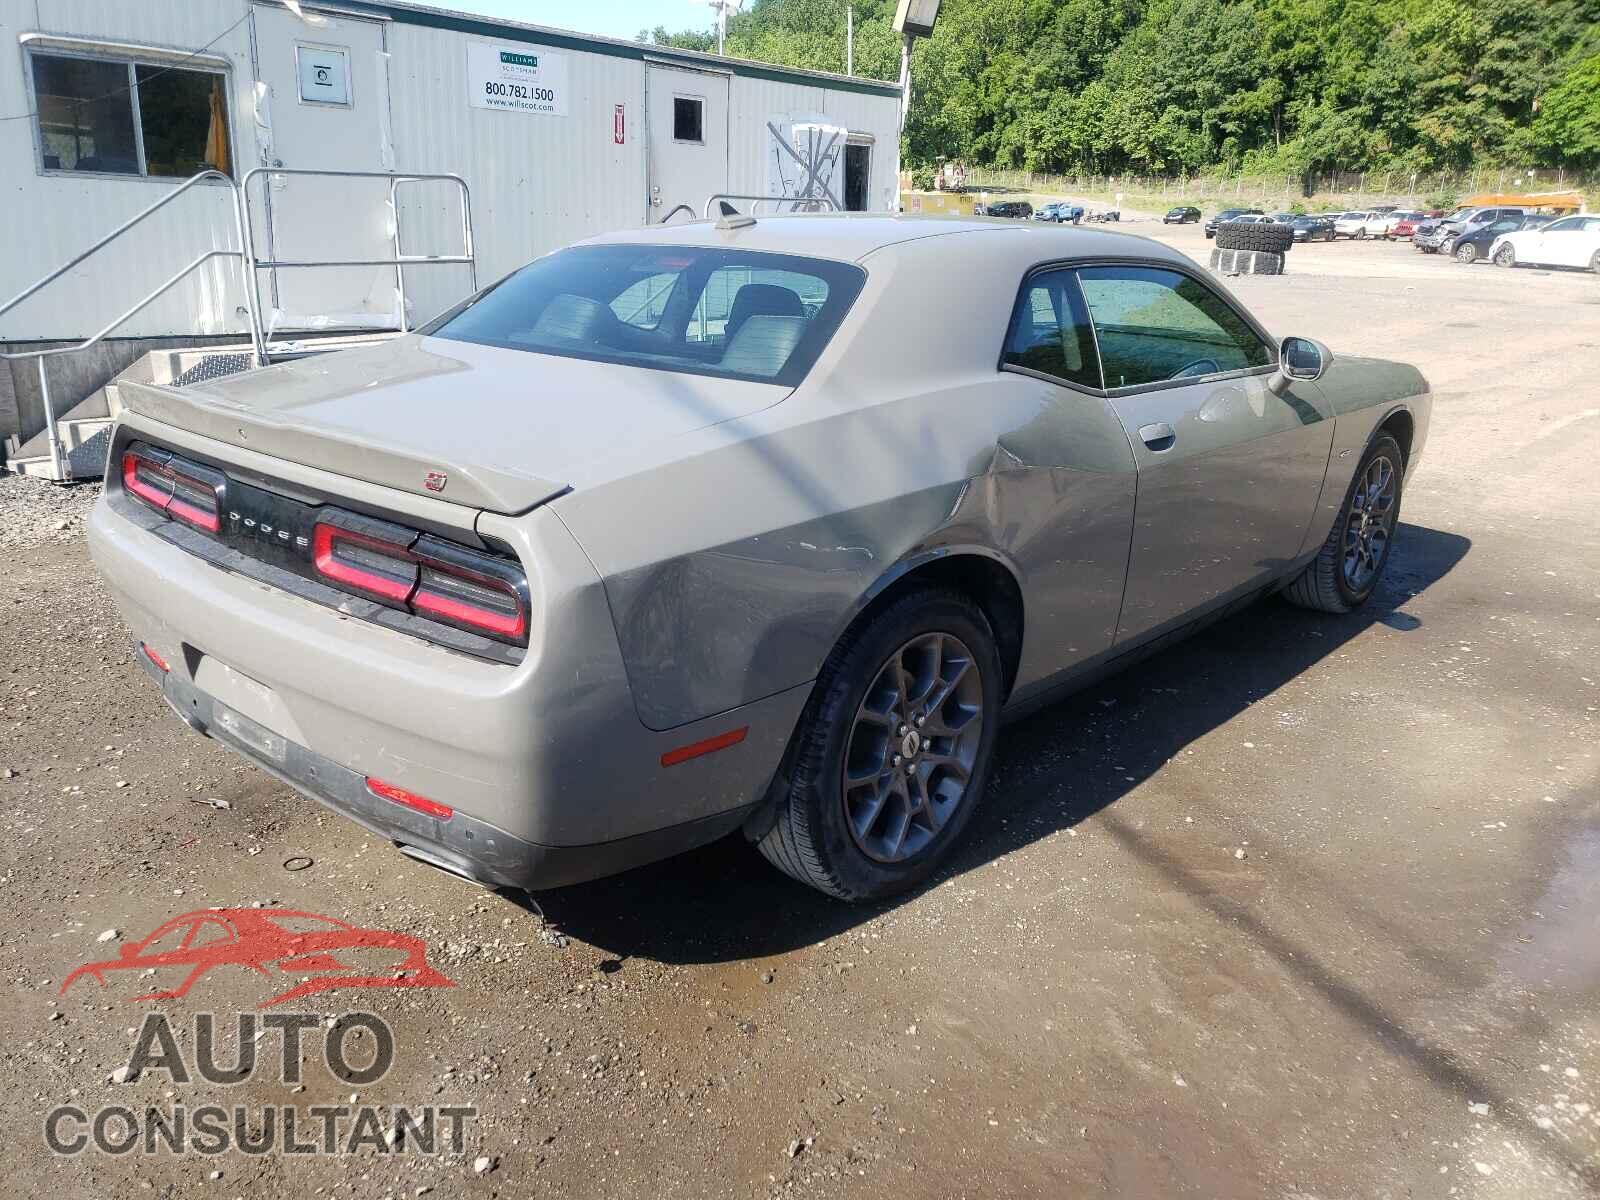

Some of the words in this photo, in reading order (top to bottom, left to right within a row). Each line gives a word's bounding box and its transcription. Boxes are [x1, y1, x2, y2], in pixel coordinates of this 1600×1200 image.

[501, 54, 537, 66] WILLIAMS
[485, 82, 554, 101] 800.782.1500
[486, 98, 554, 111] www.willscot.com
[229, 512, 308, 546] DODGE
